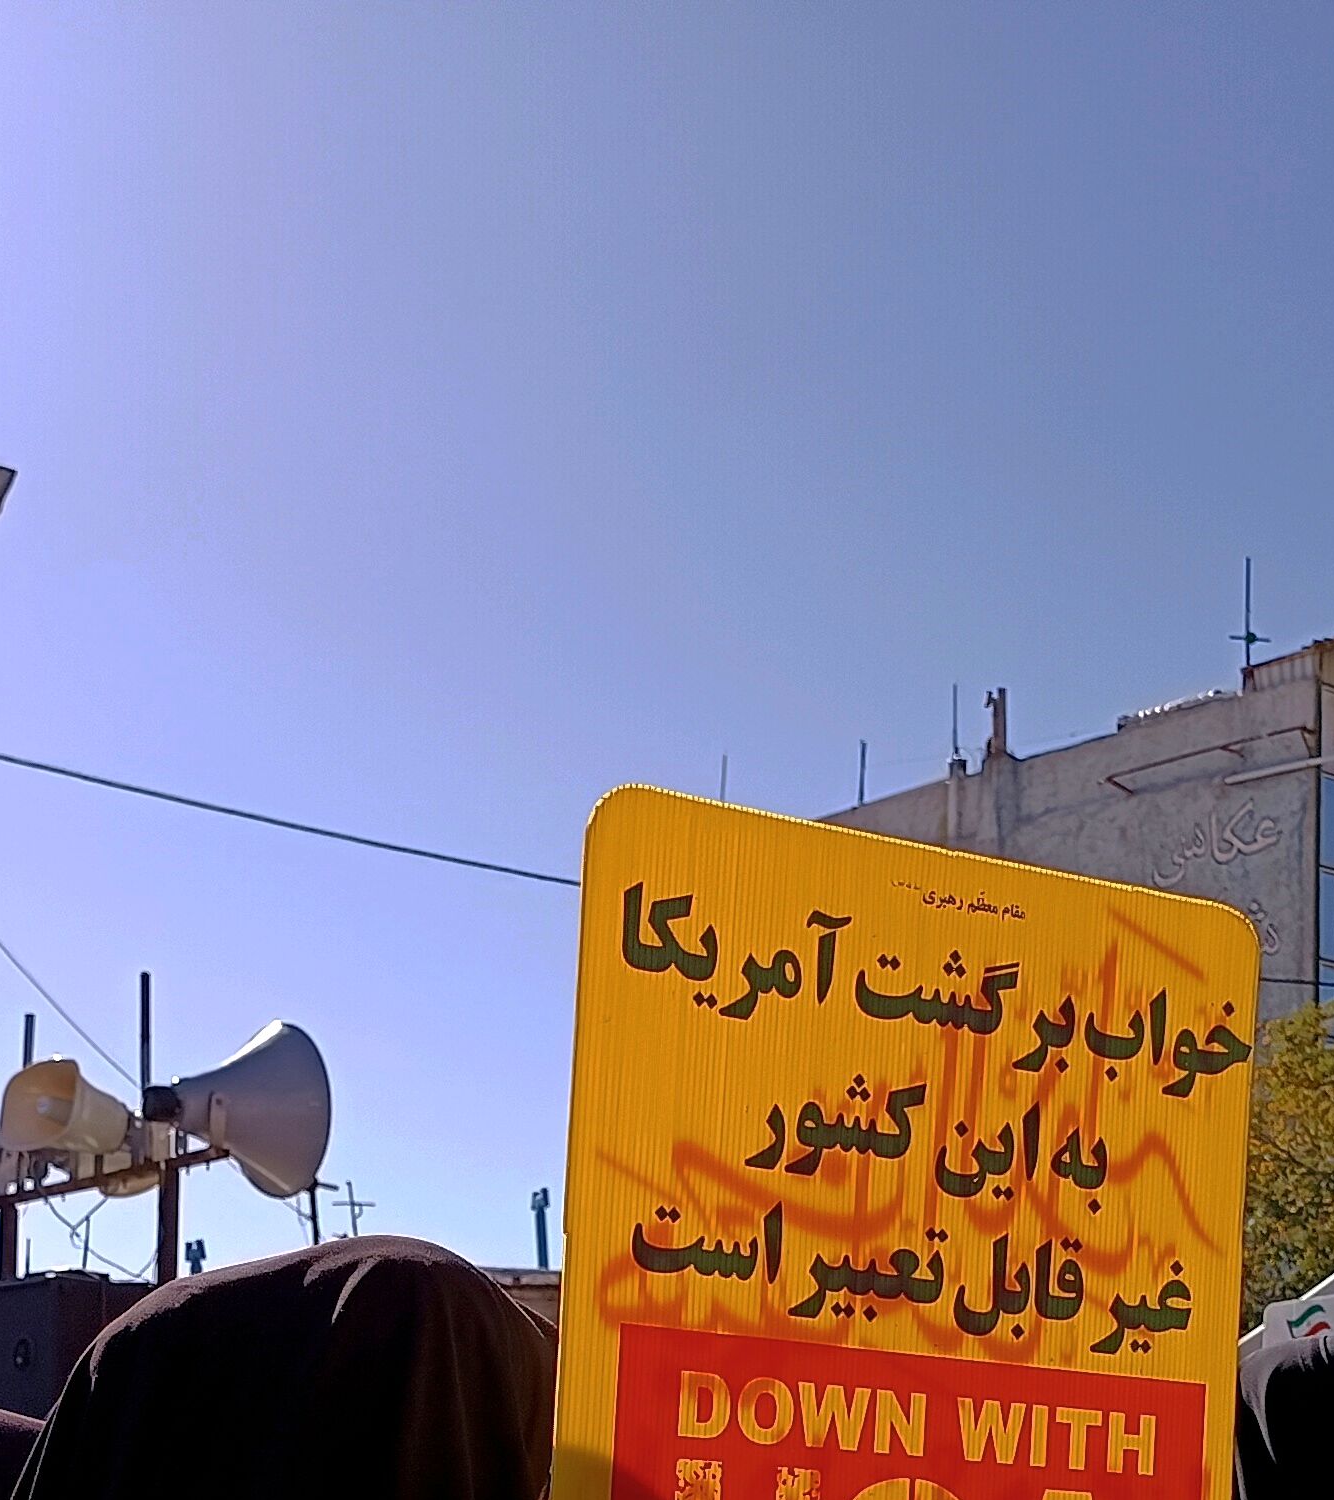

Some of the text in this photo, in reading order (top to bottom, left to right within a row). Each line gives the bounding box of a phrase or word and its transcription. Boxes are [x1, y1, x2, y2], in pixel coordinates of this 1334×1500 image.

[1152, 797, 1283, 888] عکاسی
[621, 881, 853, 1020] آمریکا
[922, 890, 964, 910] رهبری
[1001, 904, 1026, 921] مقام
[1084, 987, 1252, 1098] خواب
[743, 1073, 1110, 1215] به این کشور
[631, 1200, 1193, 1354] غیر قابل تعبیر است
[677, 1370, 1157, 1477] DOWN WITH
